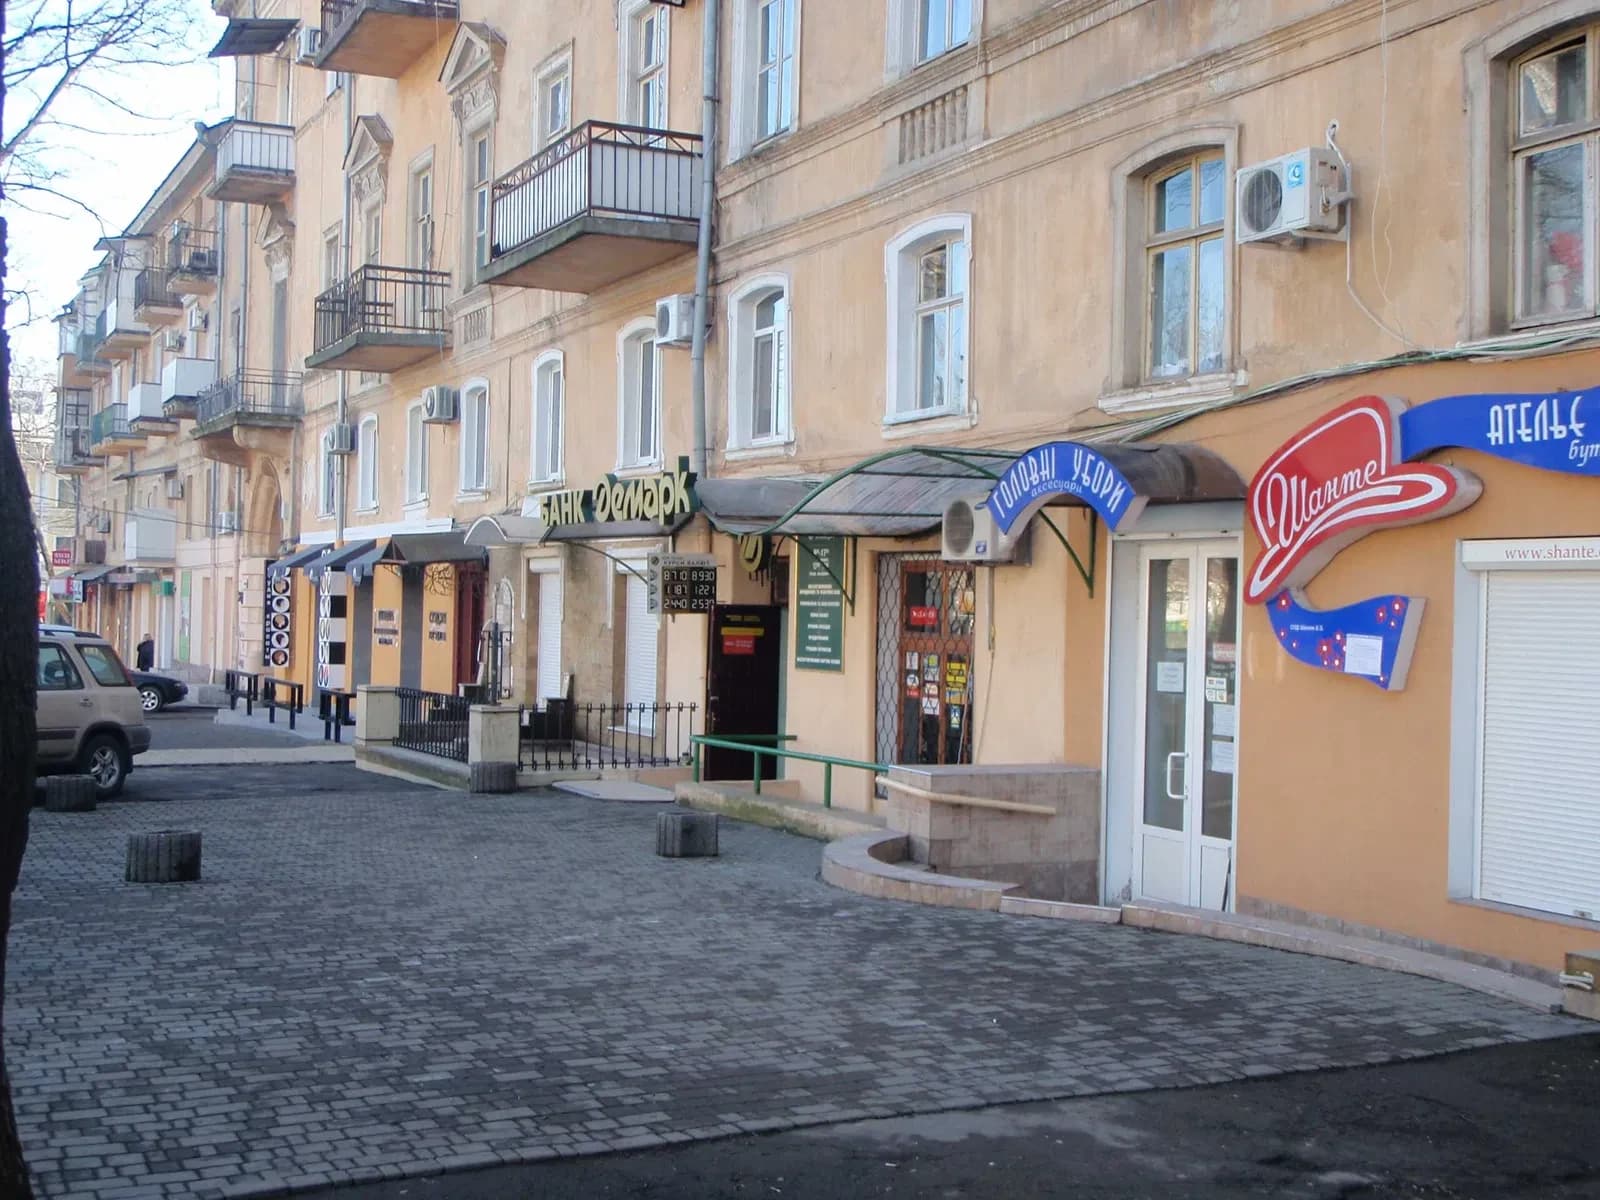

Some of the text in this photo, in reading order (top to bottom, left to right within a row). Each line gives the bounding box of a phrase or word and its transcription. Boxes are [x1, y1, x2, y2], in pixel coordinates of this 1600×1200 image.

[1486, 396, 1587, 446] АТЕЛЬЄ
[992, 446, 1127, 519] ГОЛОВНІ УБОРИ
[1031, 479, 1083, 498] аксесуари
[1266, 459, 1378, 548] Шанте
[540, 488, 586, 527] БАНК
[1505, 543, 1600, 560] www.shante.
